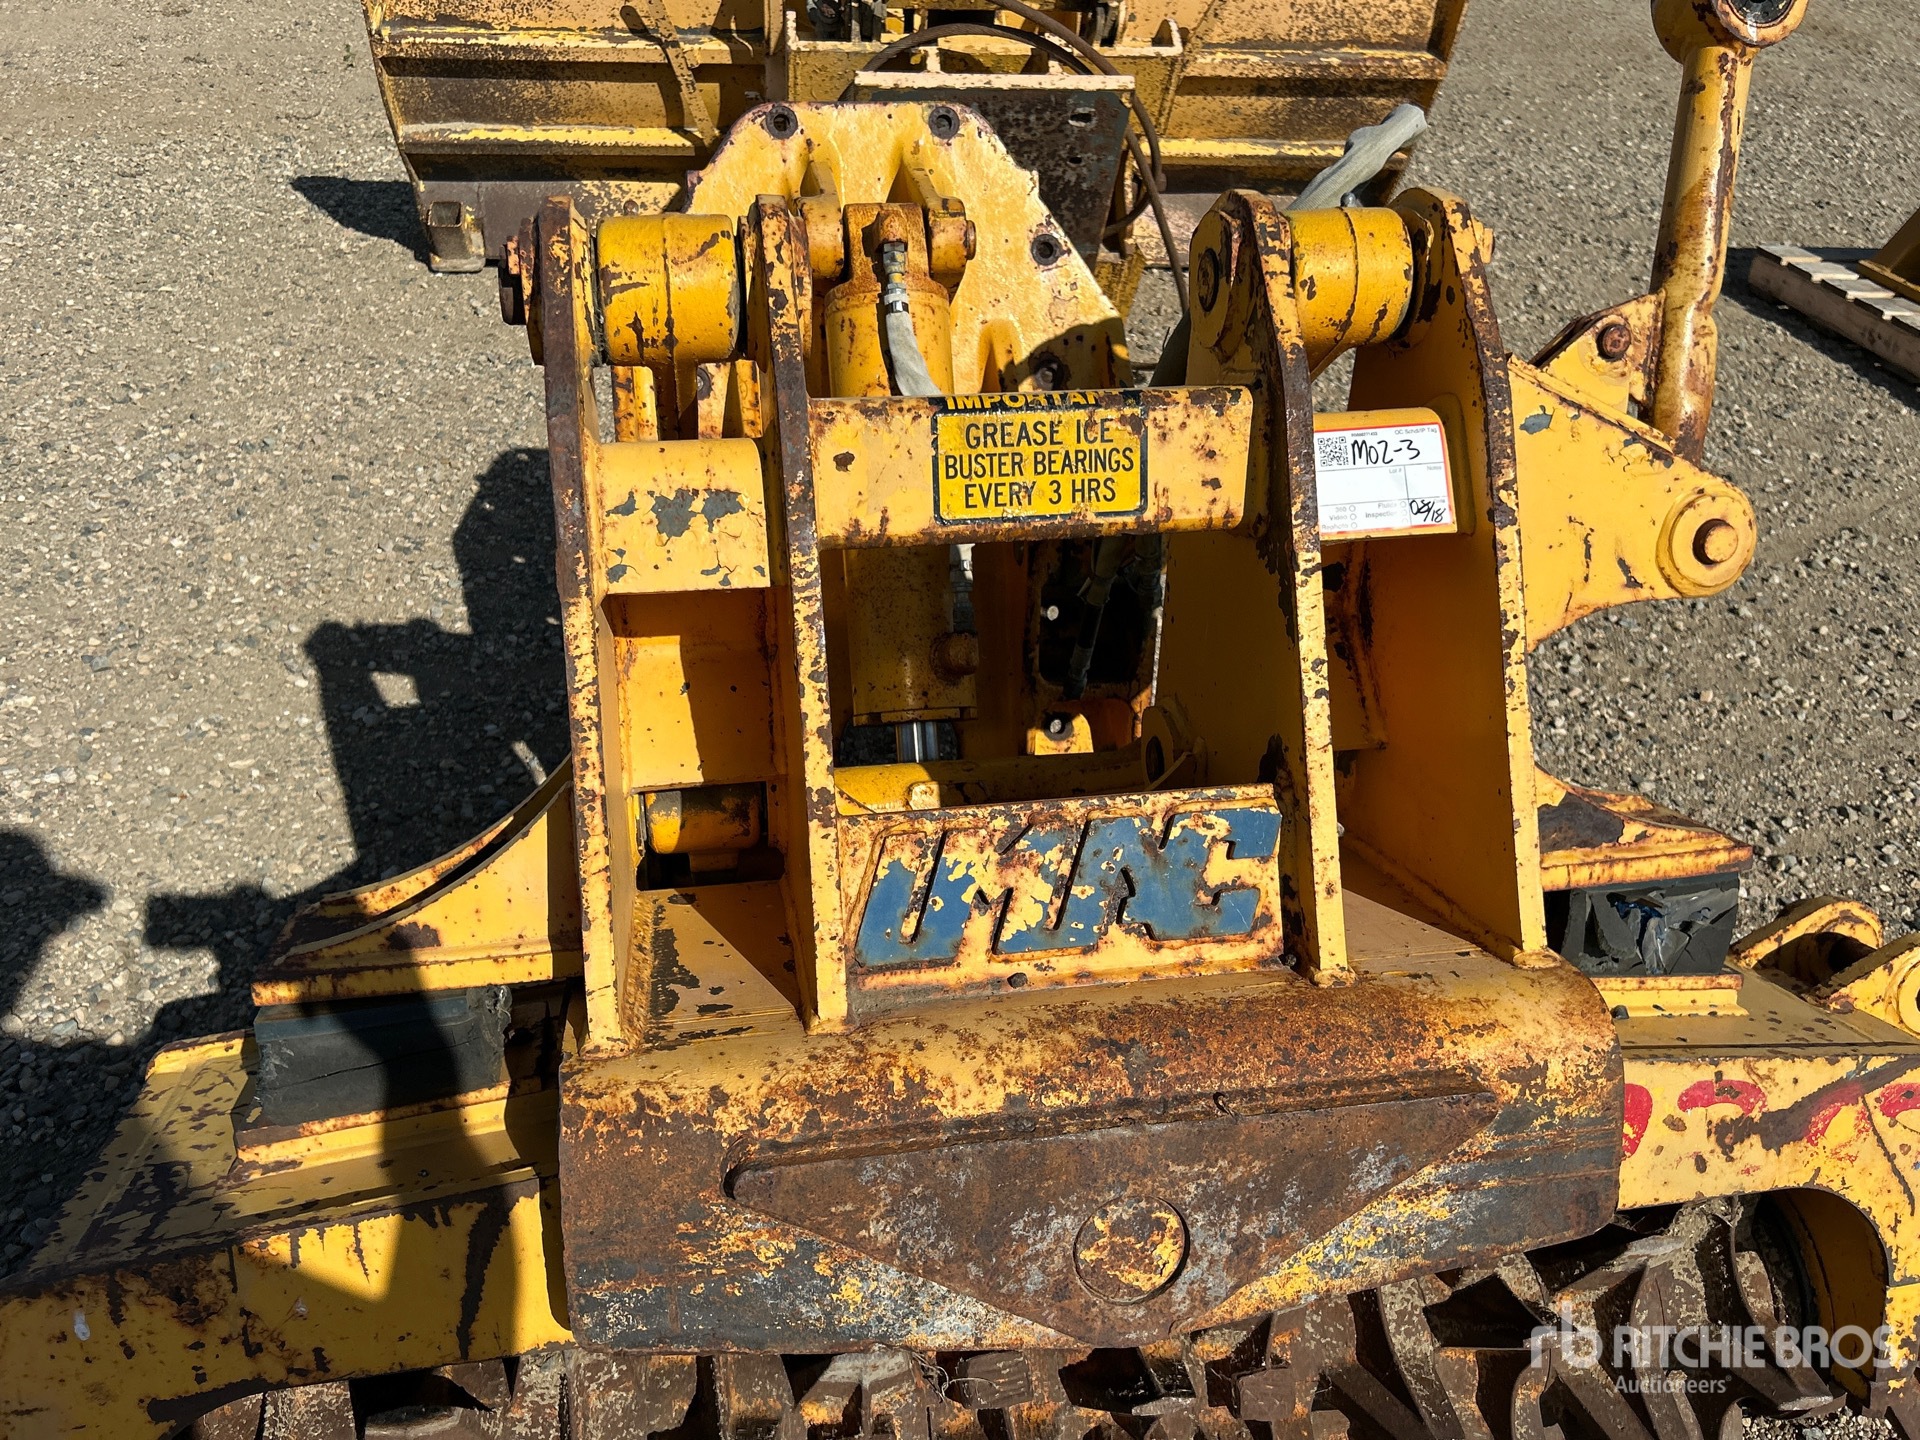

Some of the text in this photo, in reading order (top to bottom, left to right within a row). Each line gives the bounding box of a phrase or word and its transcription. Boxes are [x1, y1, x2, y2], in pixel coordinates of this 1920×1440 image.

[945, 390, 1121, 410] IMPORTAN
[964, 417, 1114, 449] GREASE ICE
[944, 446, 1135, 480] BUSTER BEARINGS
[964, 477, 1117, 509] EVERY 3 HRS
